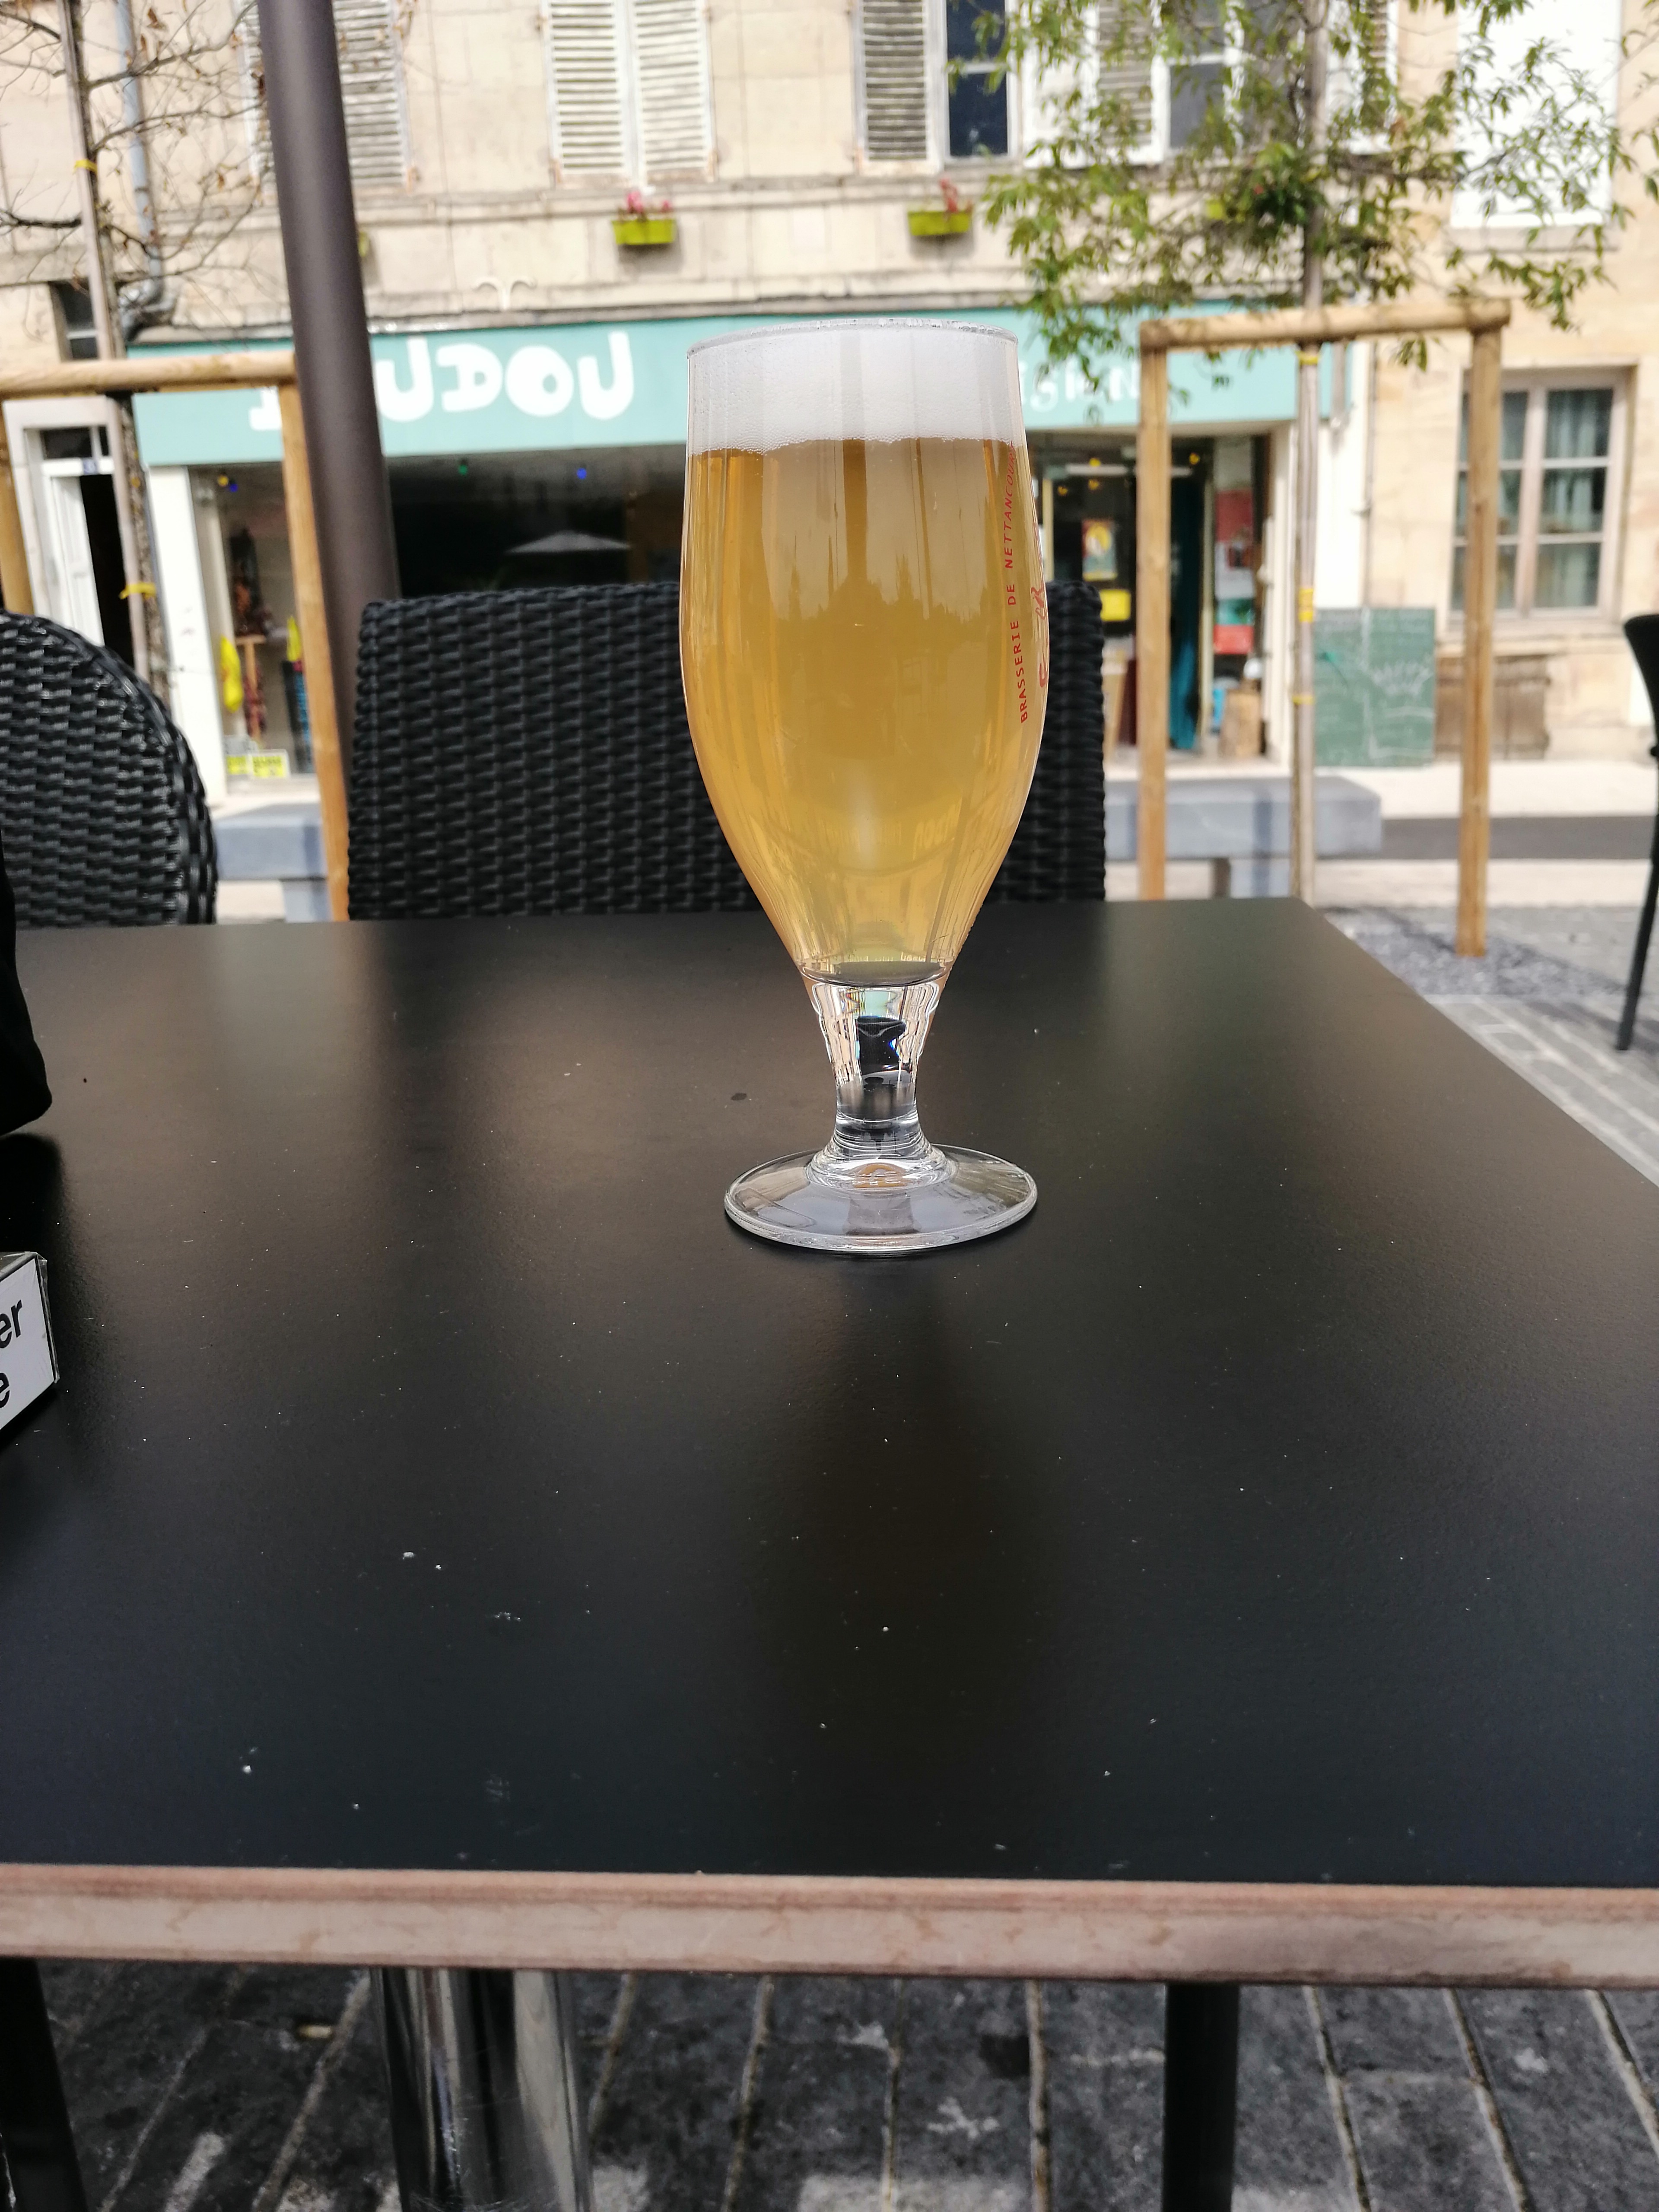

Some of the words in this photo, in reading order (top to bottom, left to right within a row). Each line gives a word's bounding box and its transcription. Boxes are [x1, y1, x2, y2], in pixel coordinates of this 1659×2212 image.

[1004, 441, 1017, 569] NETTANCOURT
[1006, 584, 1017, 606] DE
[1010, 621, 1028, 723] BRASSERIE
